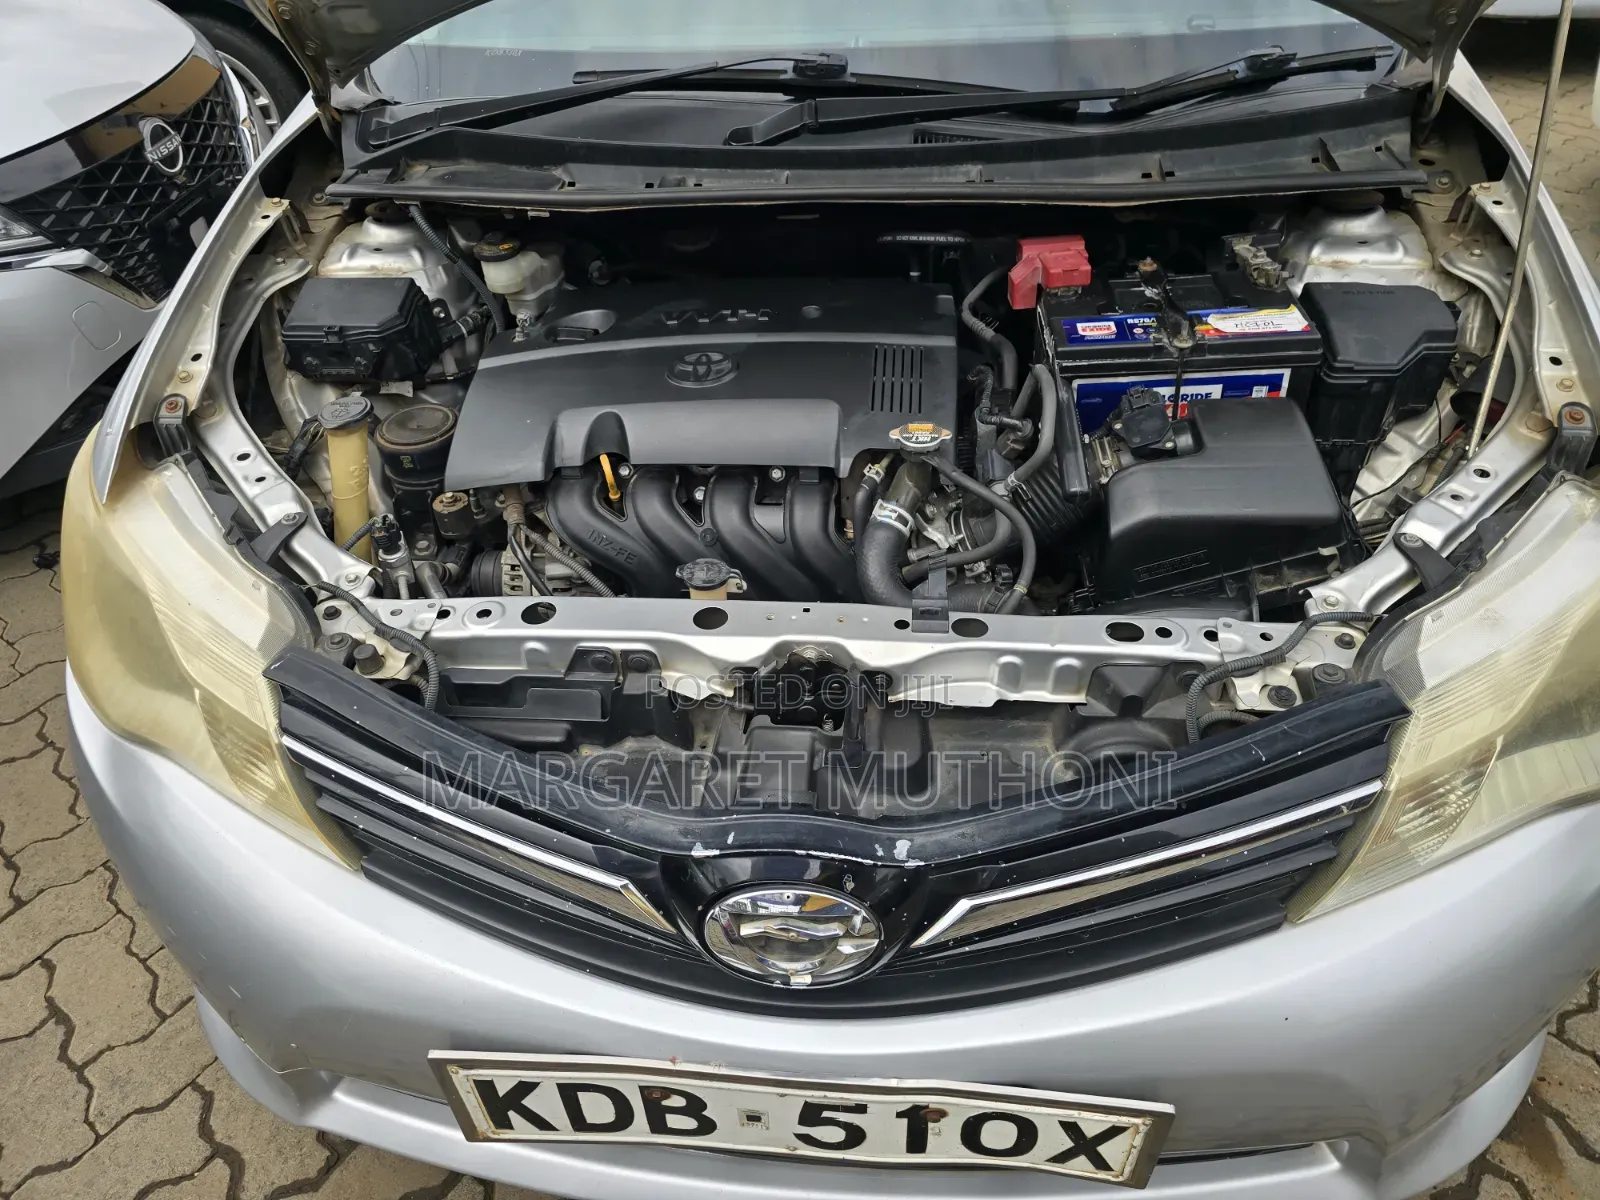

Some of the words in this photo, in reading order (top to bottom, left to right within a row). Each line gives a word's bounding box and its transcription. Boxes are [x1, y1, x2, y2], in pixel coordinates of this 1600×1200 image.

[146, 133, 182, 162] NISSAN
[472, 1078, 718, 1137] KDB
[792, 1100, 1131, 1172] 510X
